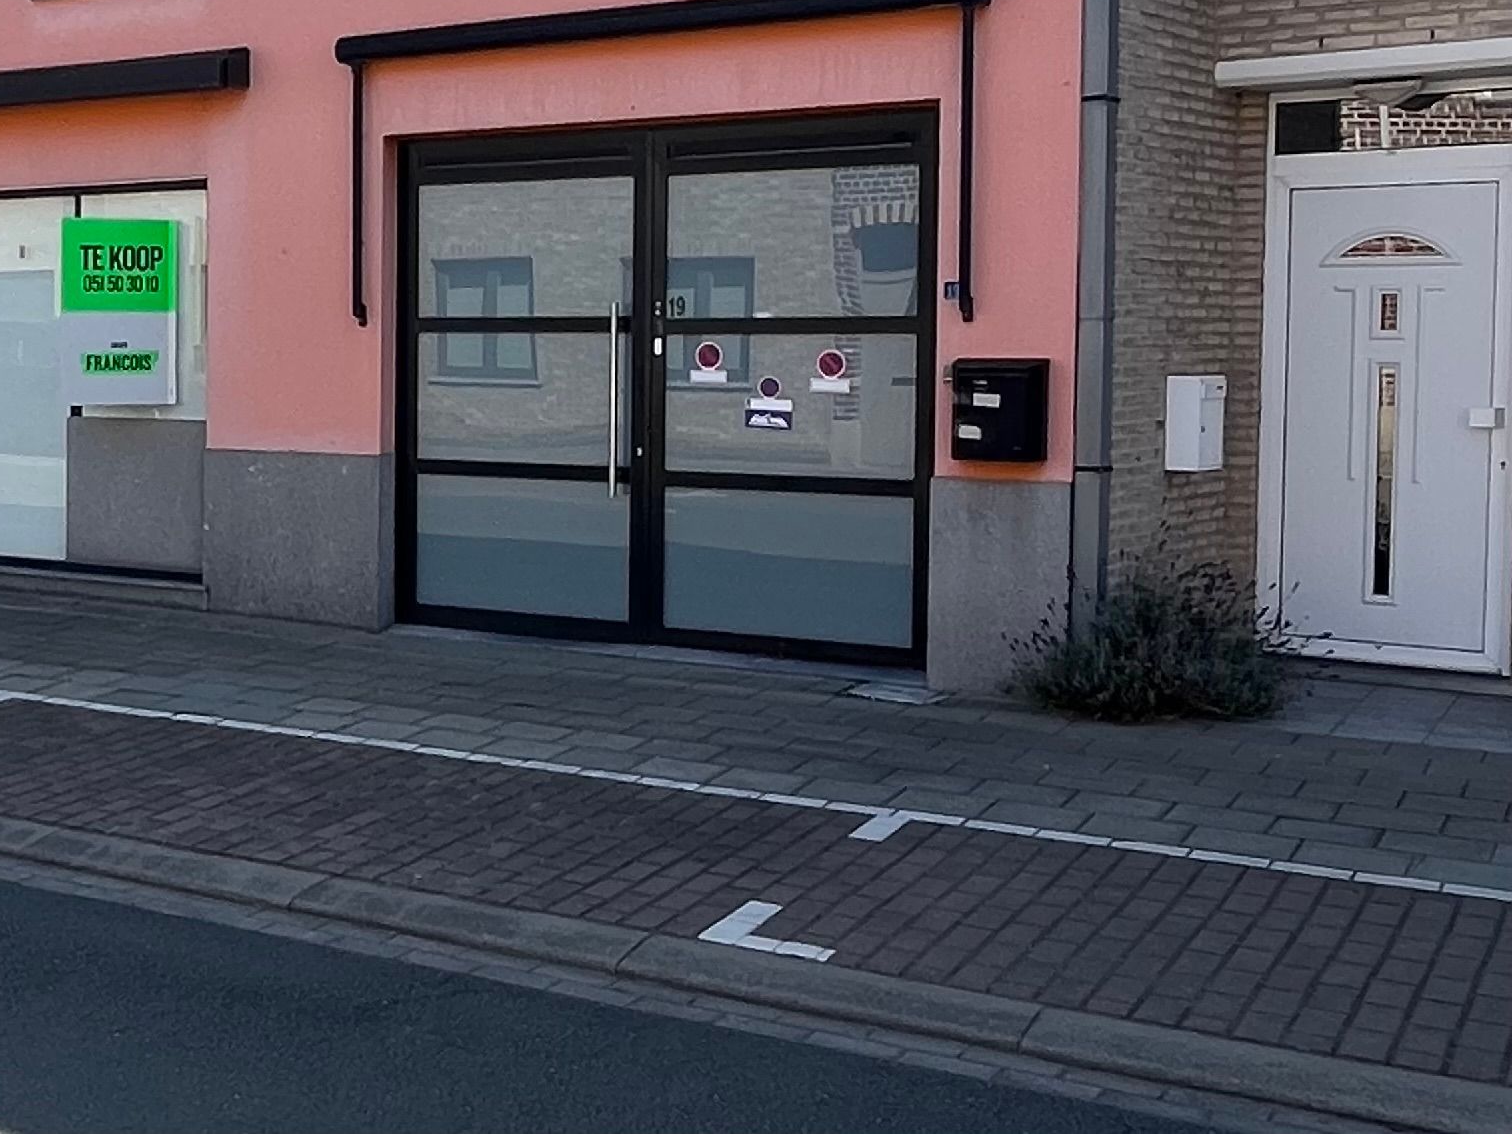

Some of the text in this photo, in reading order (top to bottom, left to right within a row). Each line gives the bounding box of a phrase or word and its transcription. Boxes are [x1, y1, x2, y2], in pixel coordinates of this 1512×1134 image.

[79, 245, 163, 272] TE KOOP
[82, 275, 159, 292] 051 50 30 10
[669, 296, 686, 317] 19
[86, 353, 152, 371] FRANCOIS
